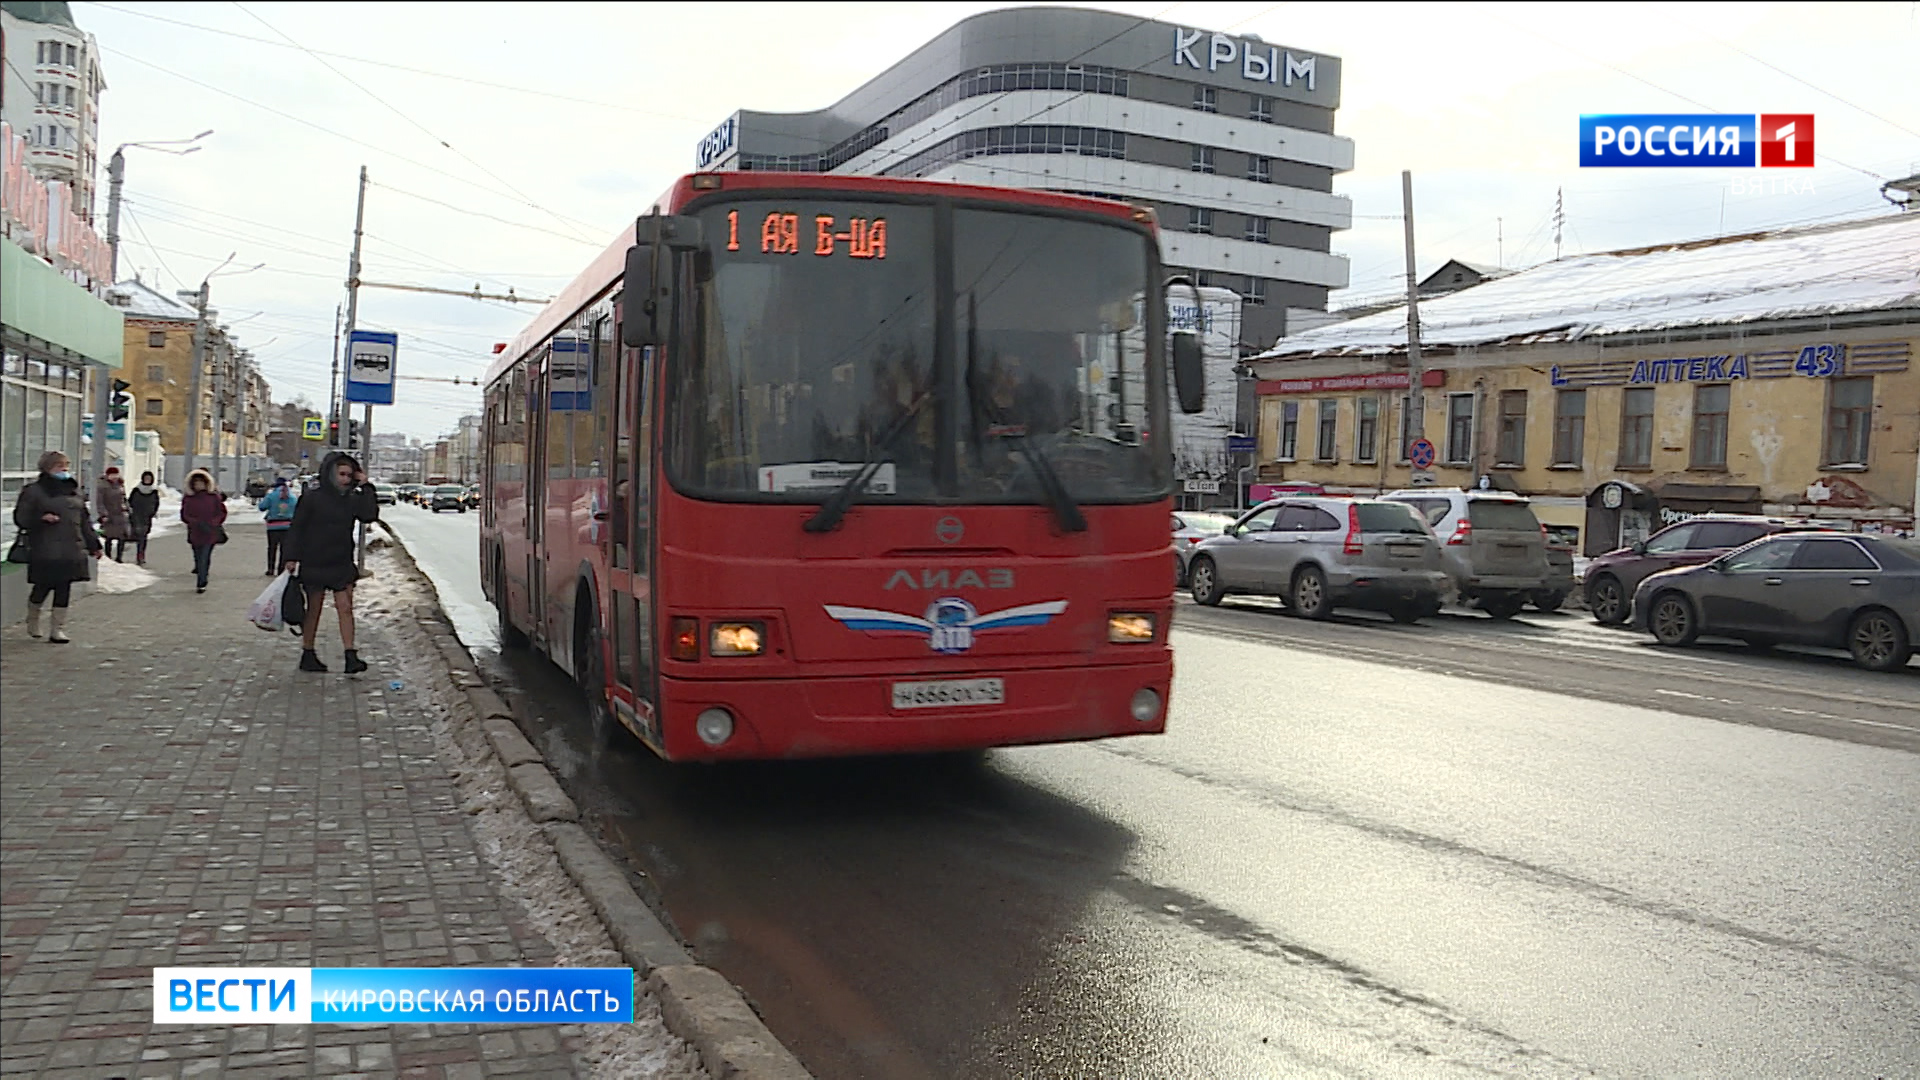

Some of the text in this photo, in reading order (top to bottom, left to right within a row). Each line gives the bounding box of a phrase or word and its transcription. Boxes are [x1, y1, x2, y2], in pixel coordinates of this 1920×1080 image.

[1175, 27, 1316, 91] КРЫМ
[699, 118, 734, 168] КРЫМ
[727, 210, 739, 251] 1
[762, 212, 798, 254] АЯ
[1630, 354, 1748, 385] АПТЕКА
[1796, 344, 1836, 378] 43
[766, 470, 774, 493] 1
[884, 569, 1015, 590] ЛИАЗ
